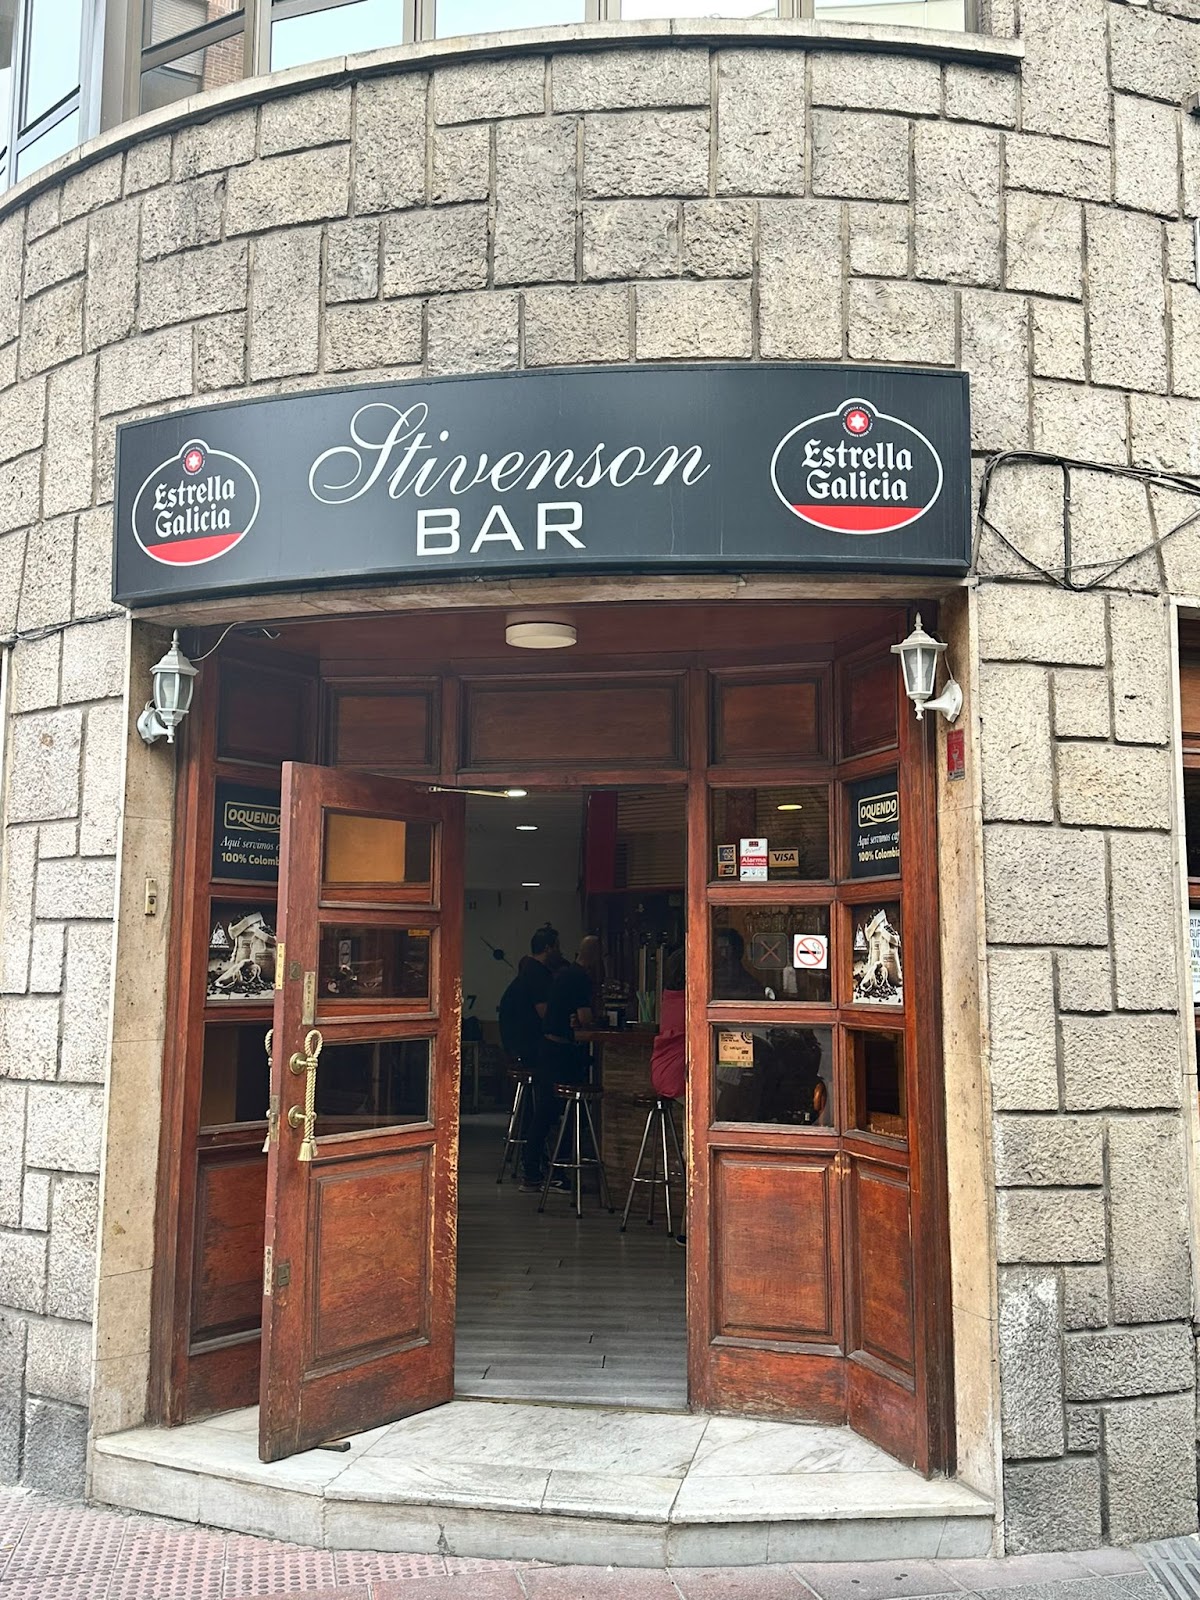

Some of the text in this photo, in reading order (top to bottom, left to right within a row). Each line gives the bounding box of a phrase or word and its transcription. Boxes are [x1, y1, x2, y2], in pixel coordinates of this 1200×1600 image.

[308, 402, 711, 505] Stivenson
[801, 438, 913, 471] Estrella
[152, 474, 236, 511] Estrella
[806, 468, 909, 502] Galicia
[155, 503, 231, 538] Galicia
[416, 501, 586, 557] BAR
[860, 799, 897, 822] OQUENDO
[221, 852, 247, 863] 100%
[242, 838, 274, 851] servimos
[773, 853, 795, 862] VISA
[858, 850, 874, 862] 100%
